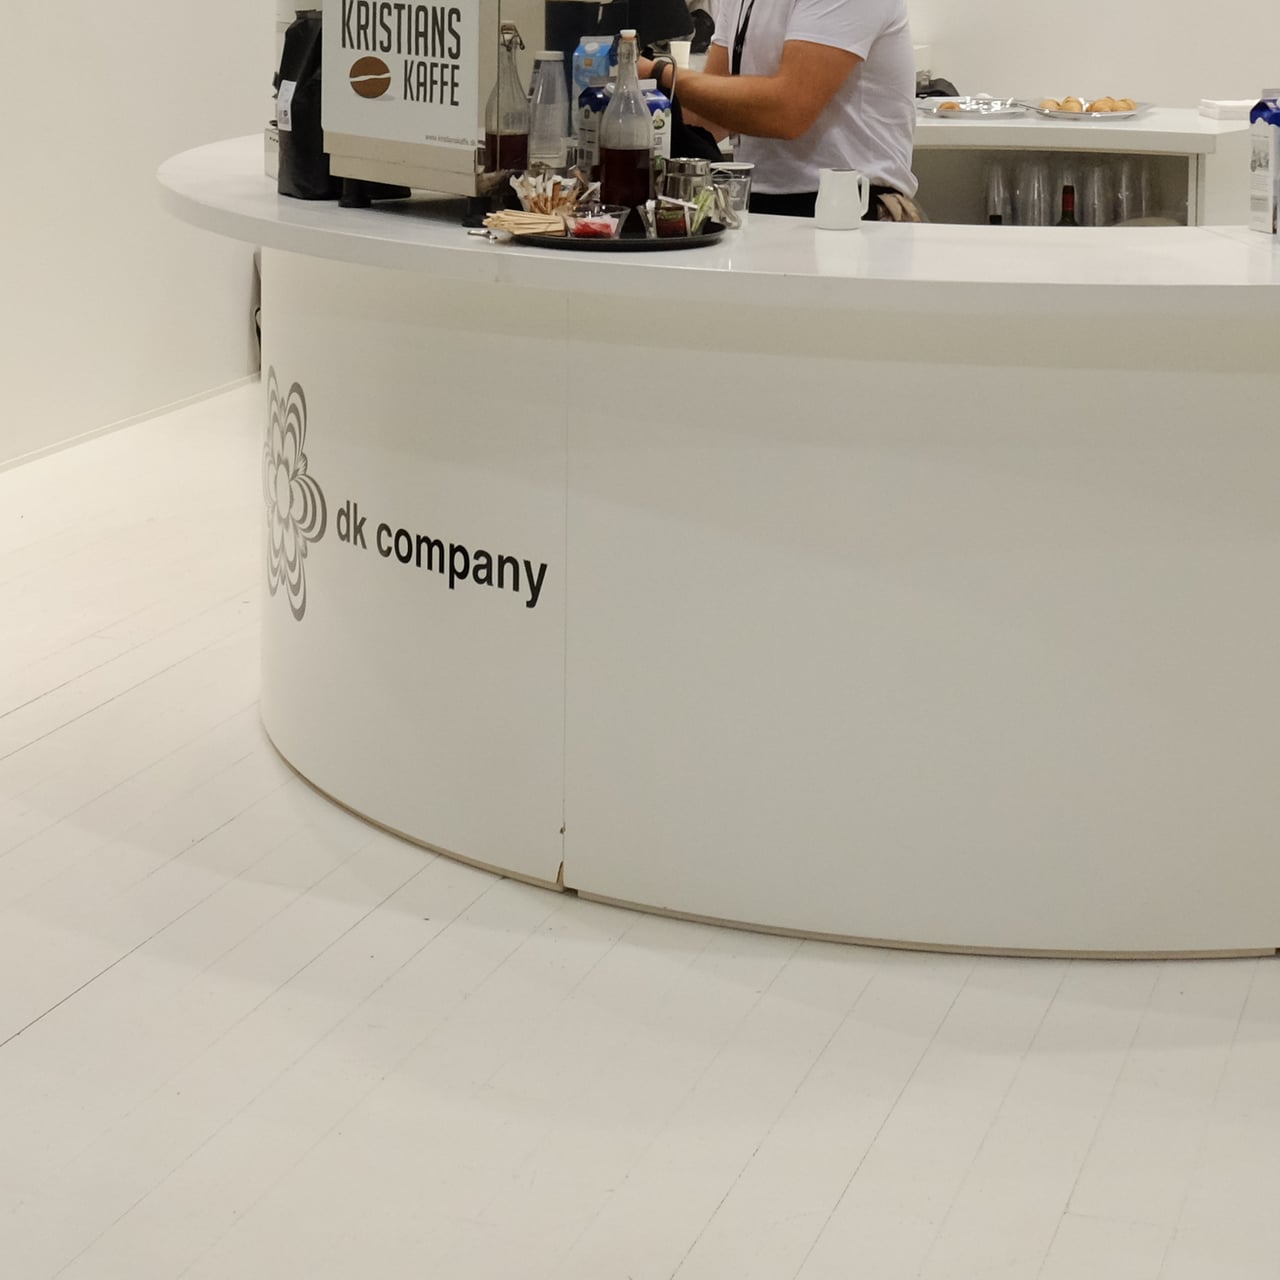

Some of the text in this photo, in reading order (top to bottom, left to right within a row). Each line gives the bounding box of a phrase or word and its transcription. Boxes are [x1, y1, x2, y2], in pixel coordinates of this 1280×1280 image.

[403, 59, 460, 107] KAFFE
[336, 499, 548, 609] dk company
